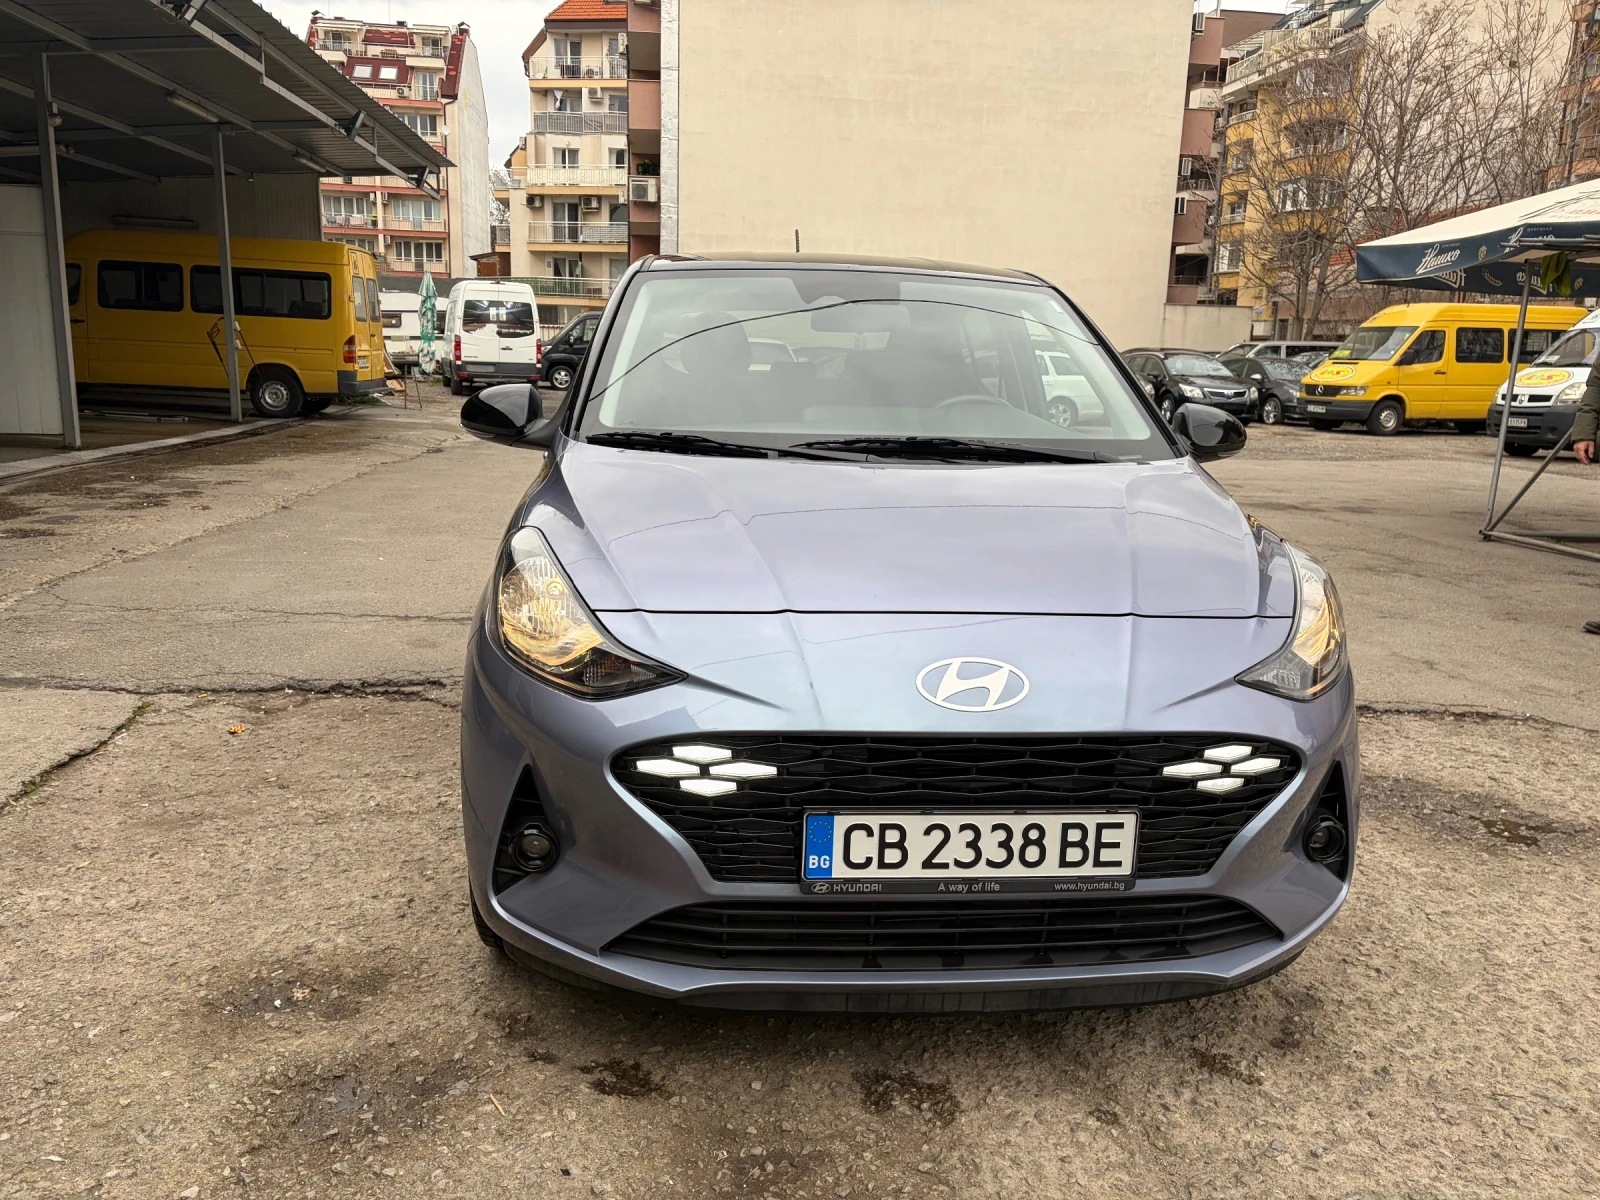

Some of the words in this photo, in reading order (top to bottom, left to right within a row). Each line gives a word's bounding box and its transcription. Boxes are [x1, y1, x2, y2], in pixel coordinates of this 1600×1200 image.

[842, 823, 909, 870] CB
[921, 823, 1047, 870] 2338
[1058, 822, 1125, 869] BE
[808, 855, 831, 869] BG
[833, 883, 882, 892] HYUNDAI
[937, 883, 946, 892] A
[948, 884, 969, 894] way
[971, 882, 983, 892] of
[984, 882, 1000, 892] life
[1054, 881, 1125, 892] www.hyundai.bg
